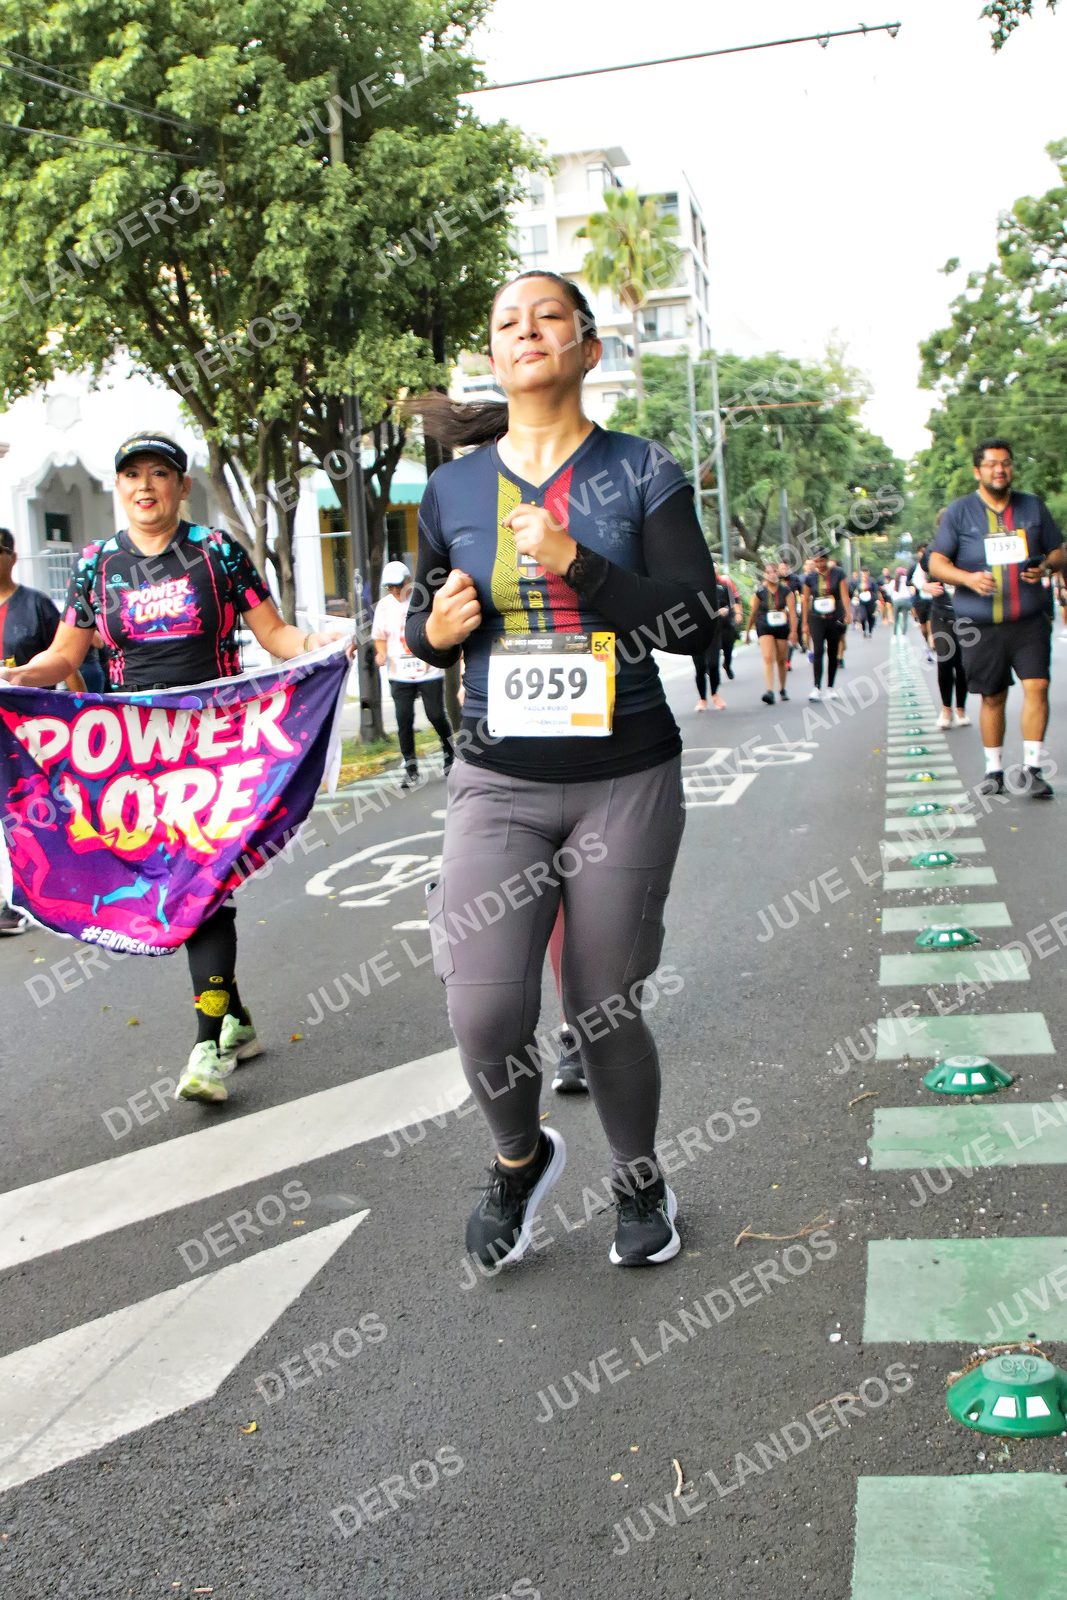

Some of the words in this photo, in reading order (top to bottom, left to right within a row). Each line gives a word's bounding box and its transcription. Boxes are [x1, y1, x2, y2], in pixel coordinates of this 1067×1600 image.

[127, 579, 190, 605] POWER
[134, 594, 186, 624] LORE
[594, 641, 609, 652] 5K
[504, 667, 588, 700] 6959
[16, 690, 295, 774] POWER
[63, 758, 266, 854] LORE
